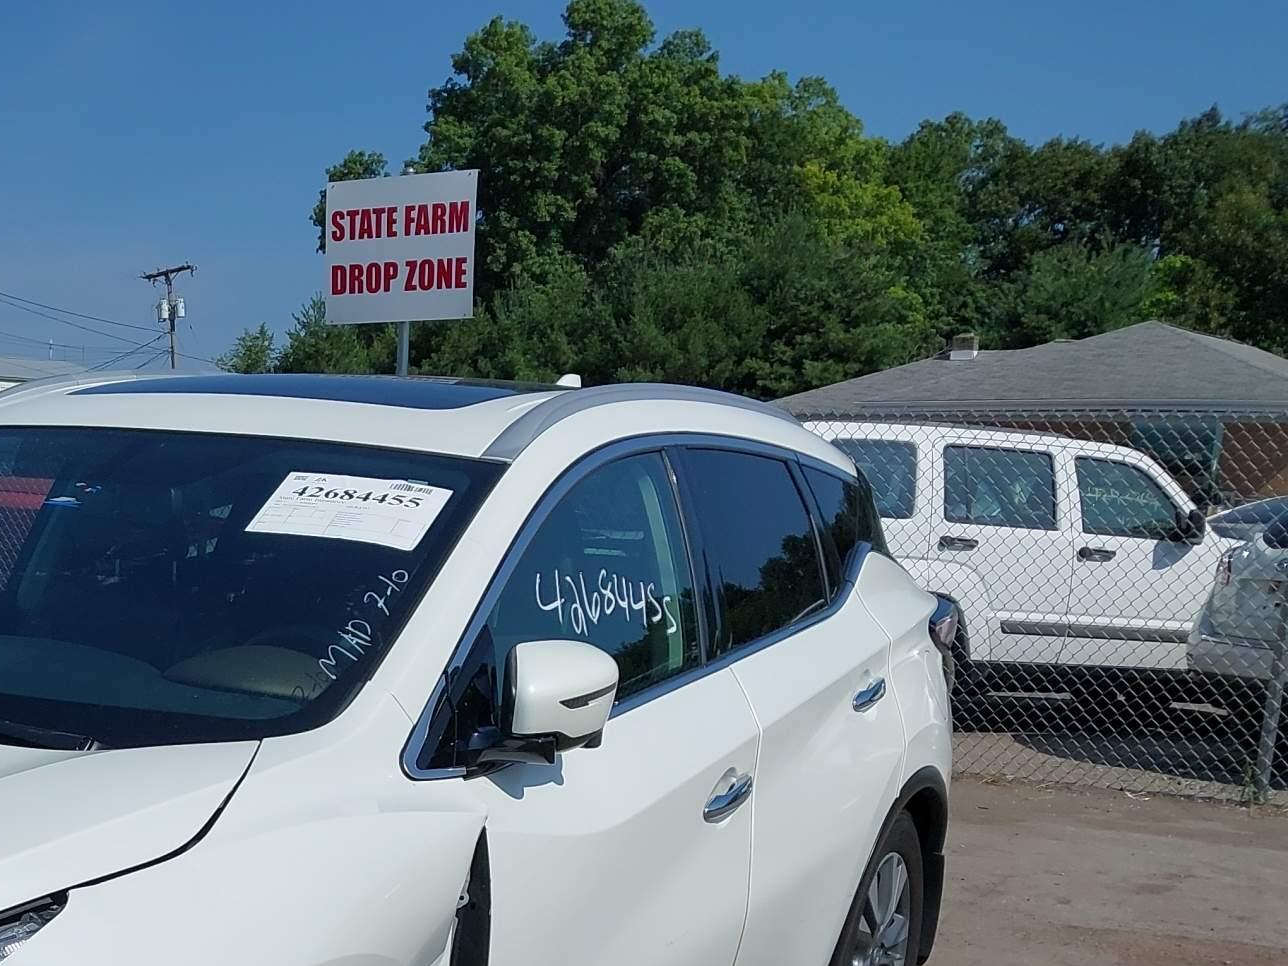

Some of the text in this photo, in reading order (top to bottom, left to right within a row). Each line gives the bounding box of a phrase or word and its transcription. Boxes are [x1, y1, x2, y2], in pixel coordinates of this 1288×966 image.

[331, 200, 470, 242] STATE FARM
[331, 257, 467, 295] DROP ZONE
[292, 485, 424, 509] 42684455
[535, 568, 678, 636] 42684455
[318, 619, 372, 680] MAD
